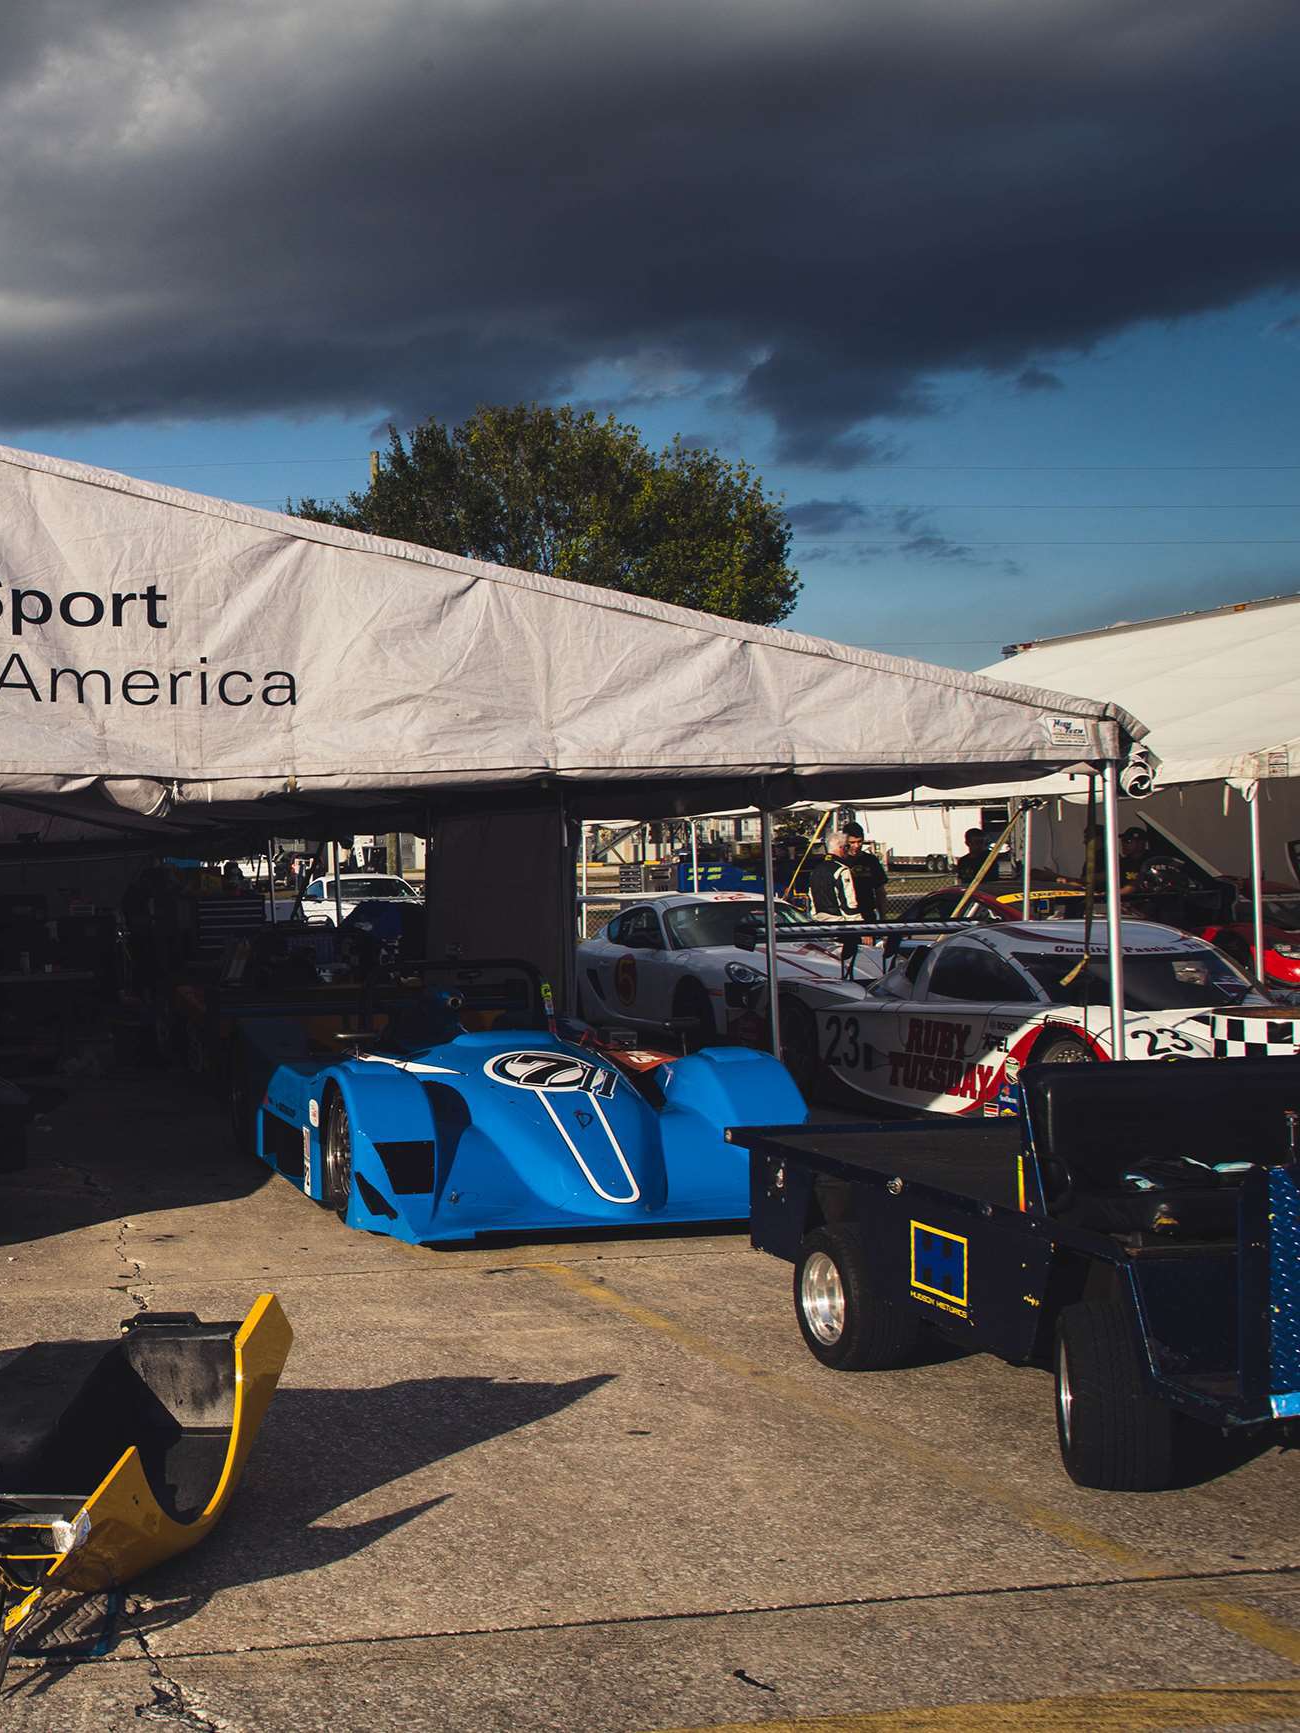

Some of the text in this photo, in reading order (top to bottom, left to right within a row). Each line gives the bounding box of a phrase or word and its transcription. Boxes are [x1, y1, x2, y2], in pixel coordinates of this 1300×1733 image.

[1054, 945, 1111, 953] Quaity
[826, 1015, 860, 1068] 23
[906, 1018, 972, 1059] RUBY
[1130, 1028, 1194, 1056] 23
[888, 1051, 994, 1100] TUESDAY
